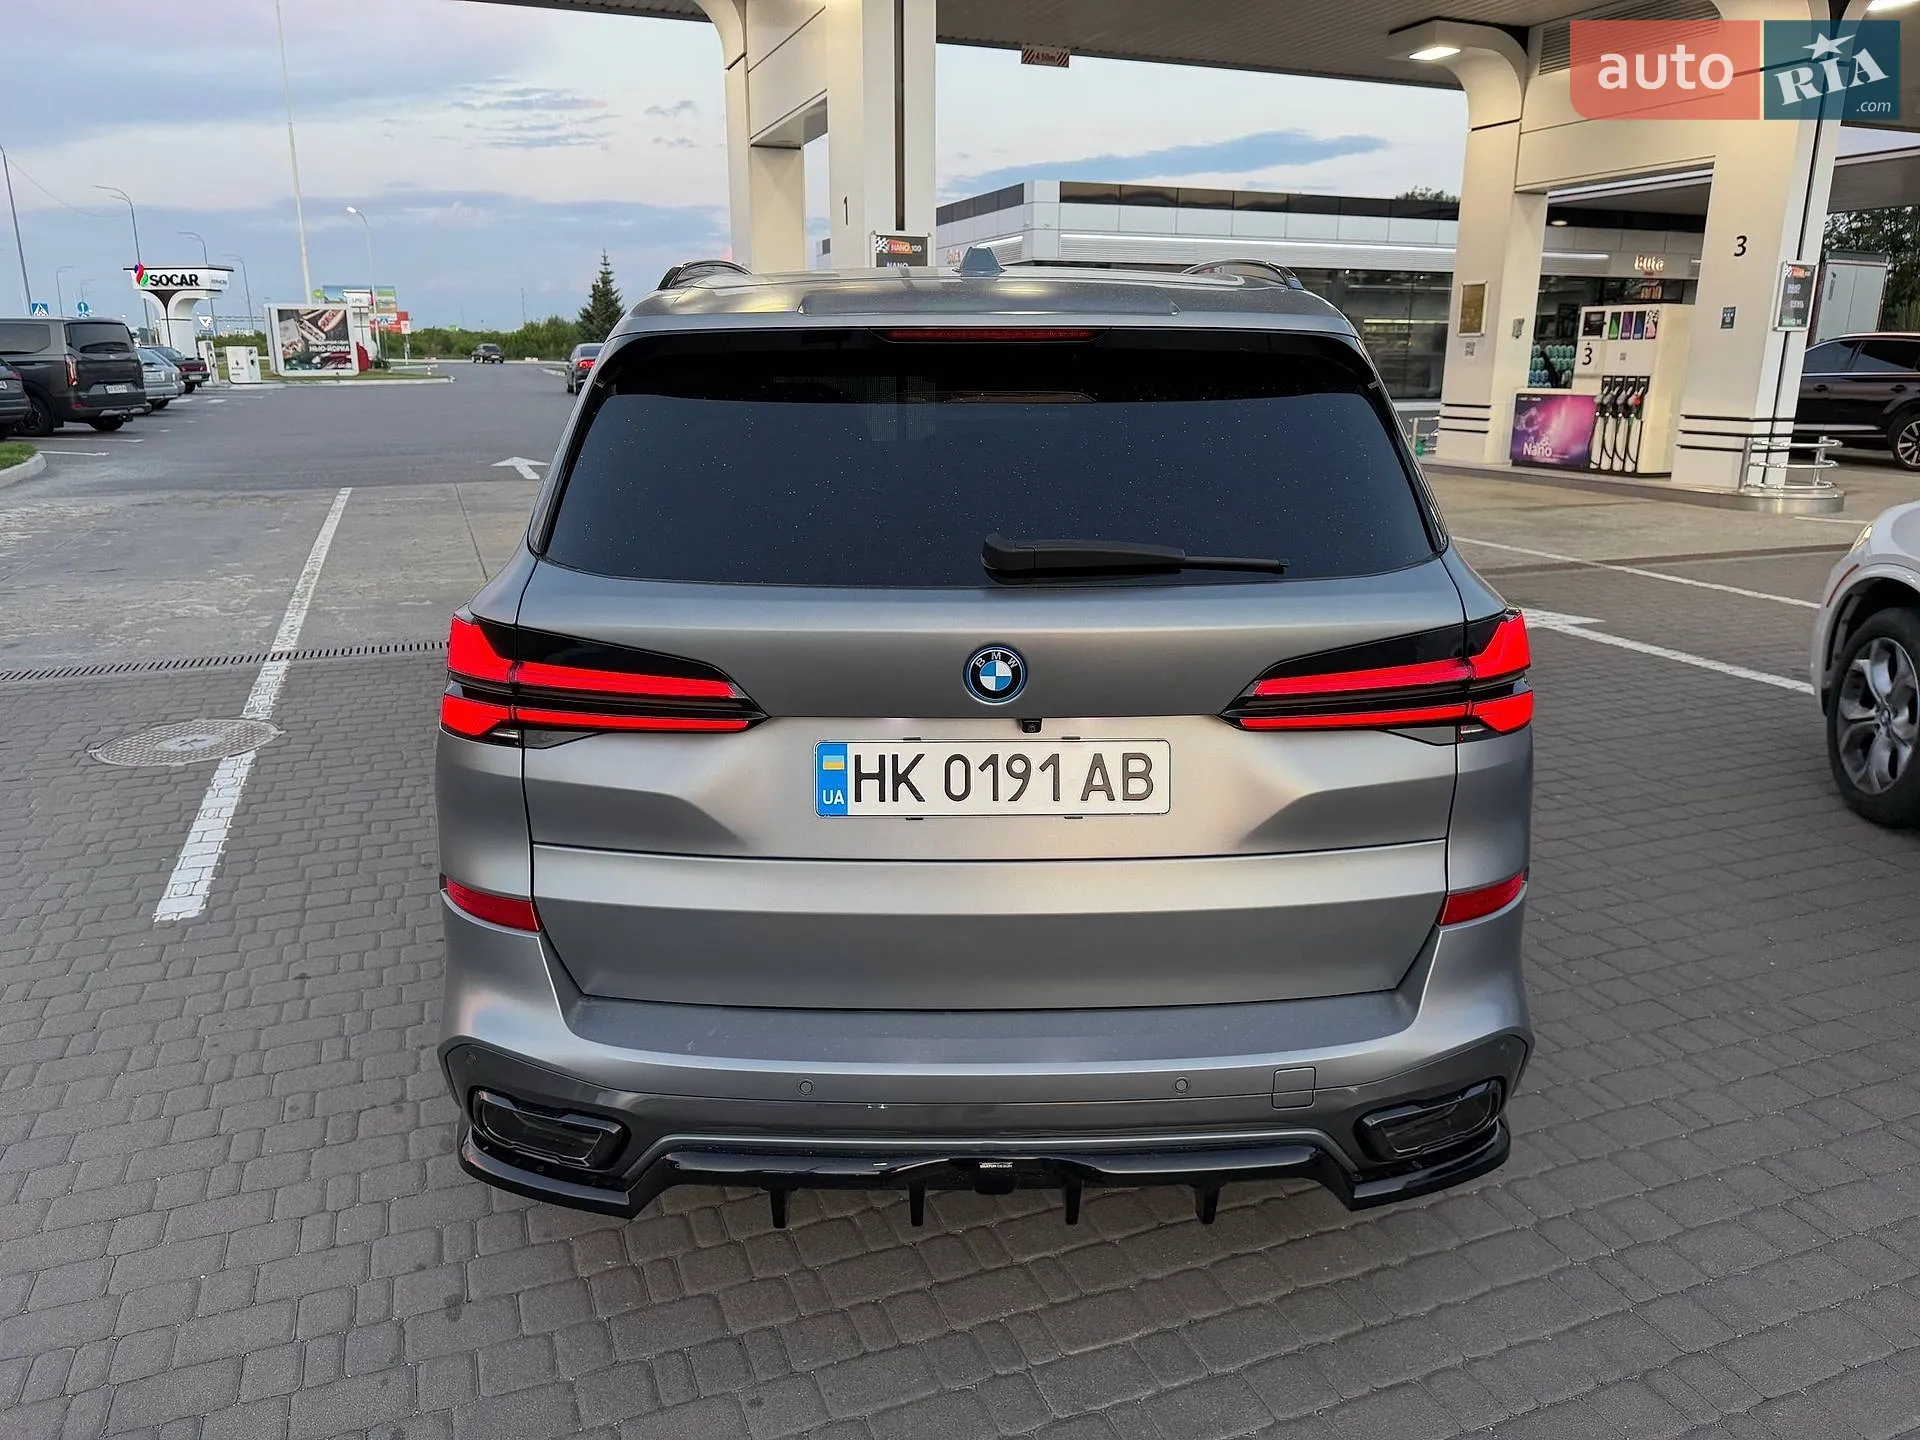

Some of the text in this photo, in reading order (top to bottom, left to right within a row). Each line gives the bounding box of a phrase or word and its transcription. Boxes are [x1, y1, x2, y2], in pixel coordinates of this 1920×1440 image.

[843, 195, 849, 226] 1
[1734, 235, 1747, 257] 3
[149, 274, 199, 286] SOCAR
[1582, 347, 1593, 365] 3
[1522, 442, 1552, 457] Nano
[975, 651, 1018, 668] BMW
[854, 752, 1154, 802] HK 0191 AB
[823, 790, 845, 805] UA
